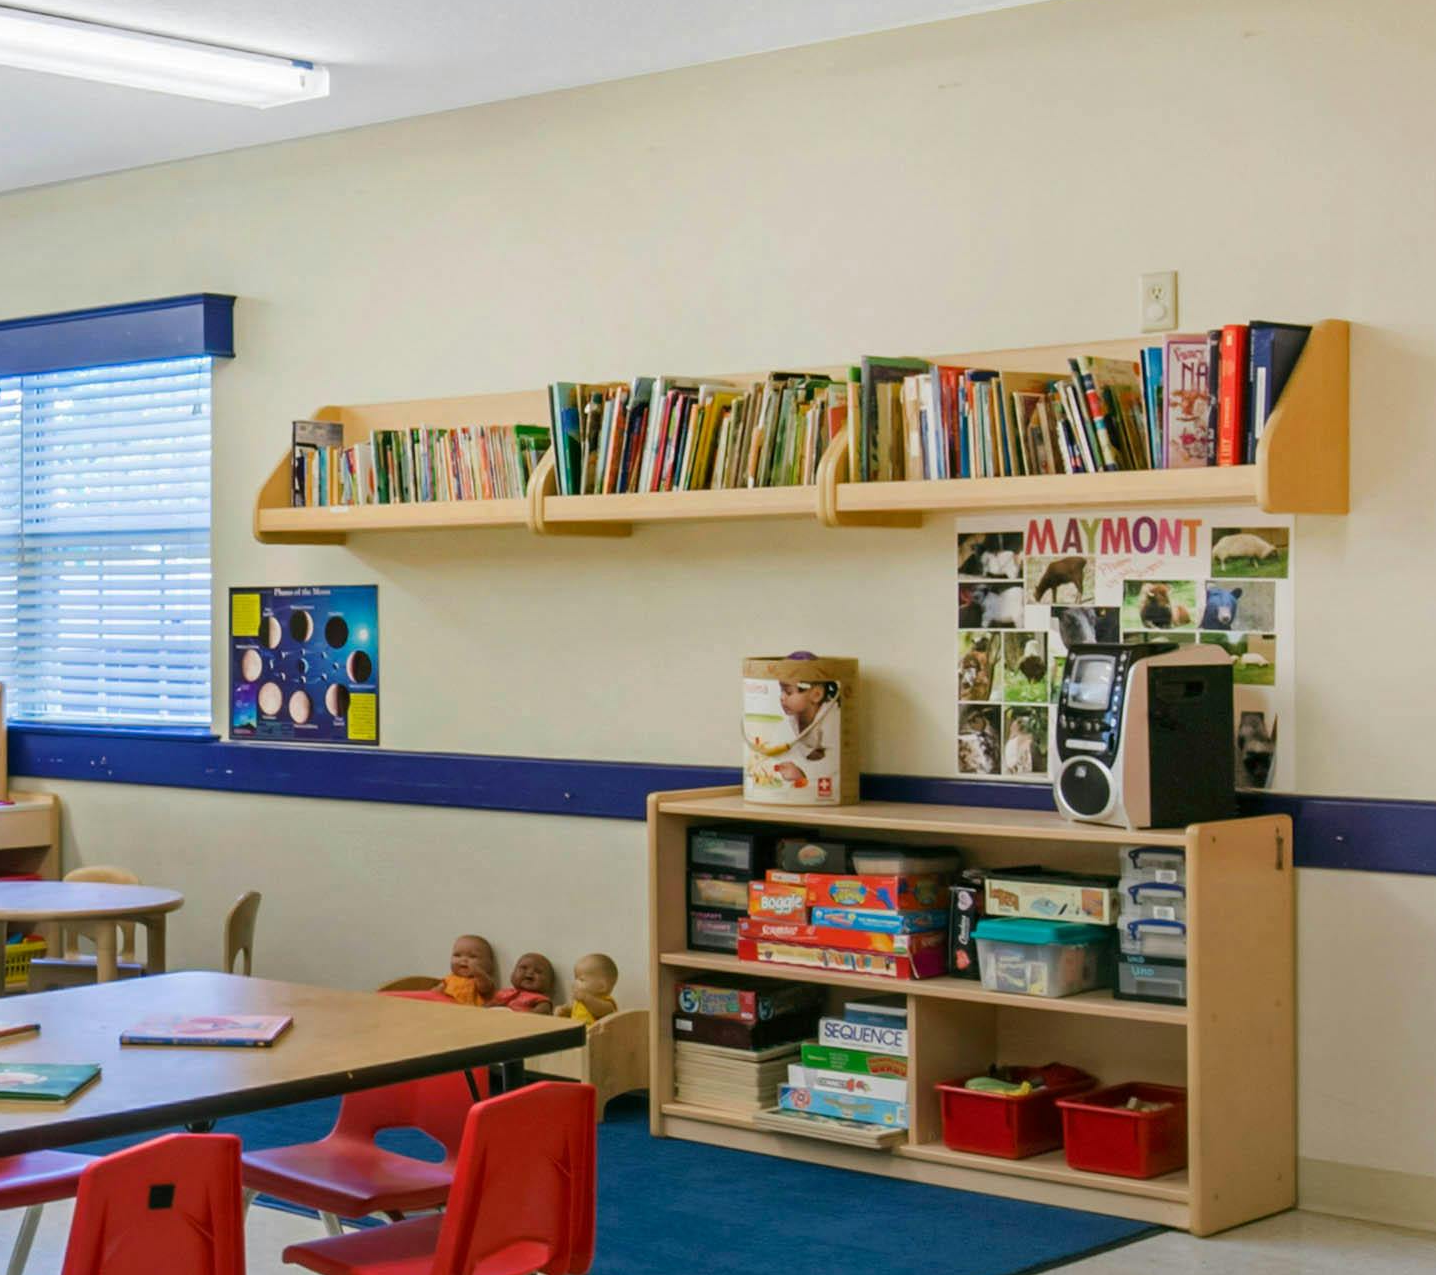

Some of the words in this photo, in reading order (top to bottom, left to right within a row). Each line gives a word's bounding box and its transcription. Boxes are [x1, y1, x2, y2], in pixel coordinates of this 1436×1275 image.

[1025, 515, 1203, 557] MAYMONT
[760, 891, 804, 915] Boggle
[683, 990, 696, 1012] 5
[824, 1021, 904, 1047] SEQUENCE
